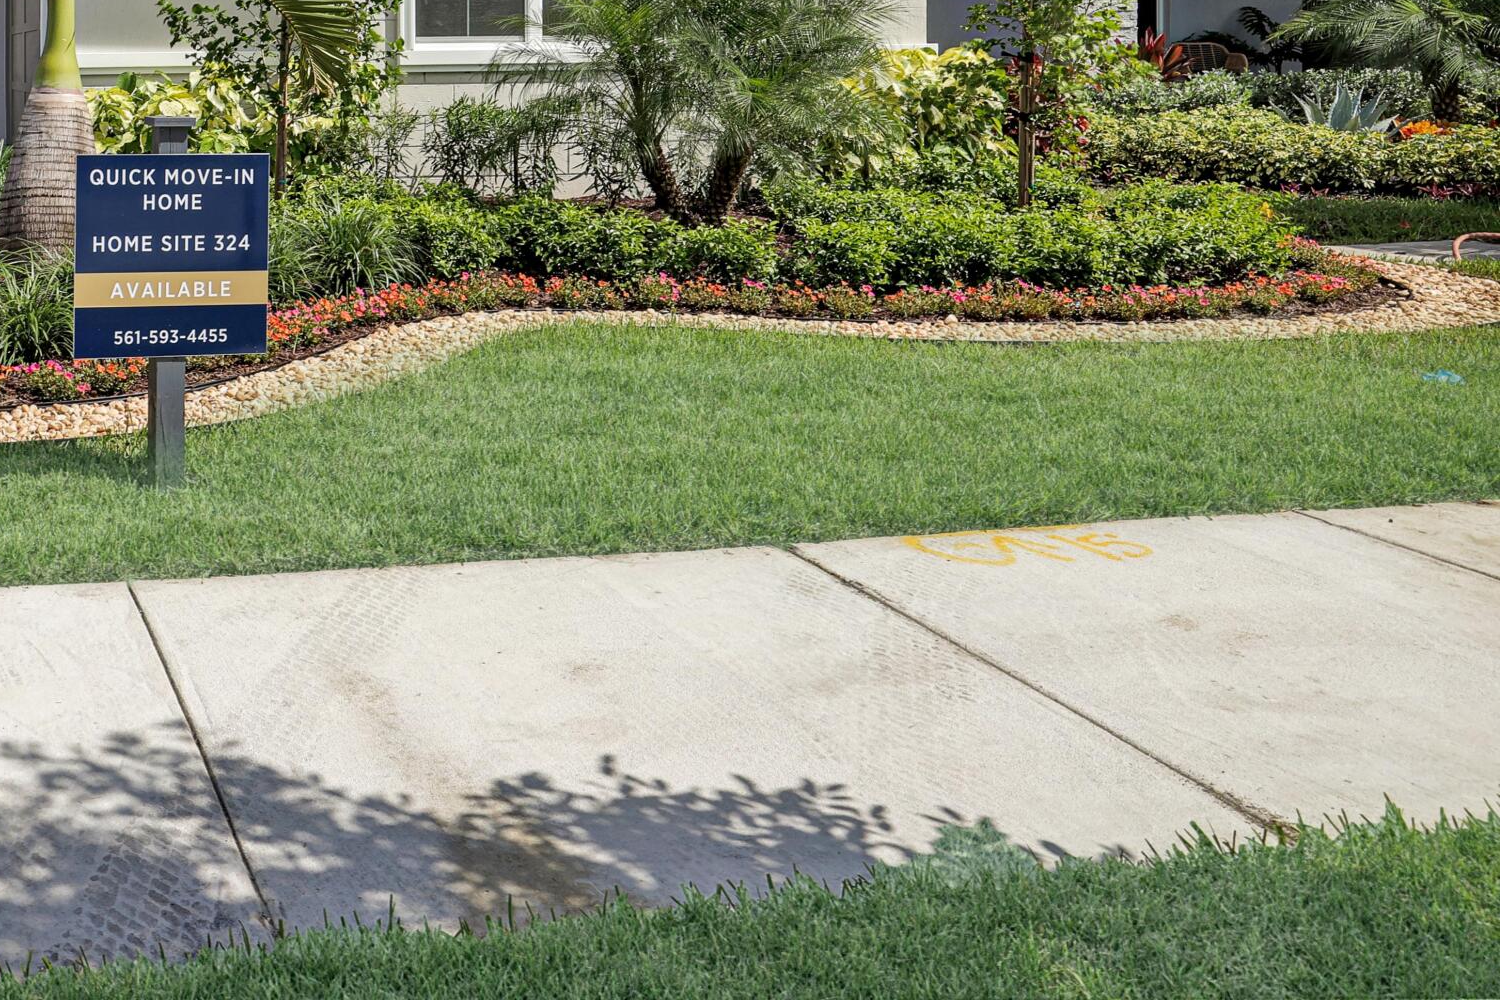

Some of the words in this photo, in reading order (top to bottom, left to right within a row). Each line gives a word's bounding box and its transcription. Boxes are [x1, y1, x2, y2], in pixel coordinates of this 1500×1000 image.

[89, 168, 156, 186] QUICK
[164, 167, 255, 185] MOVE-IN
[142, 193, 203, 211] HOME
[92, 235, 153, 253] HOME
[160, 234, 206, 252] SITE
[213, 233, 251, 251] 324
[109, 280, 232, 299] AVAILABLE
[113, 327, 228, 345] 561-593-4455
